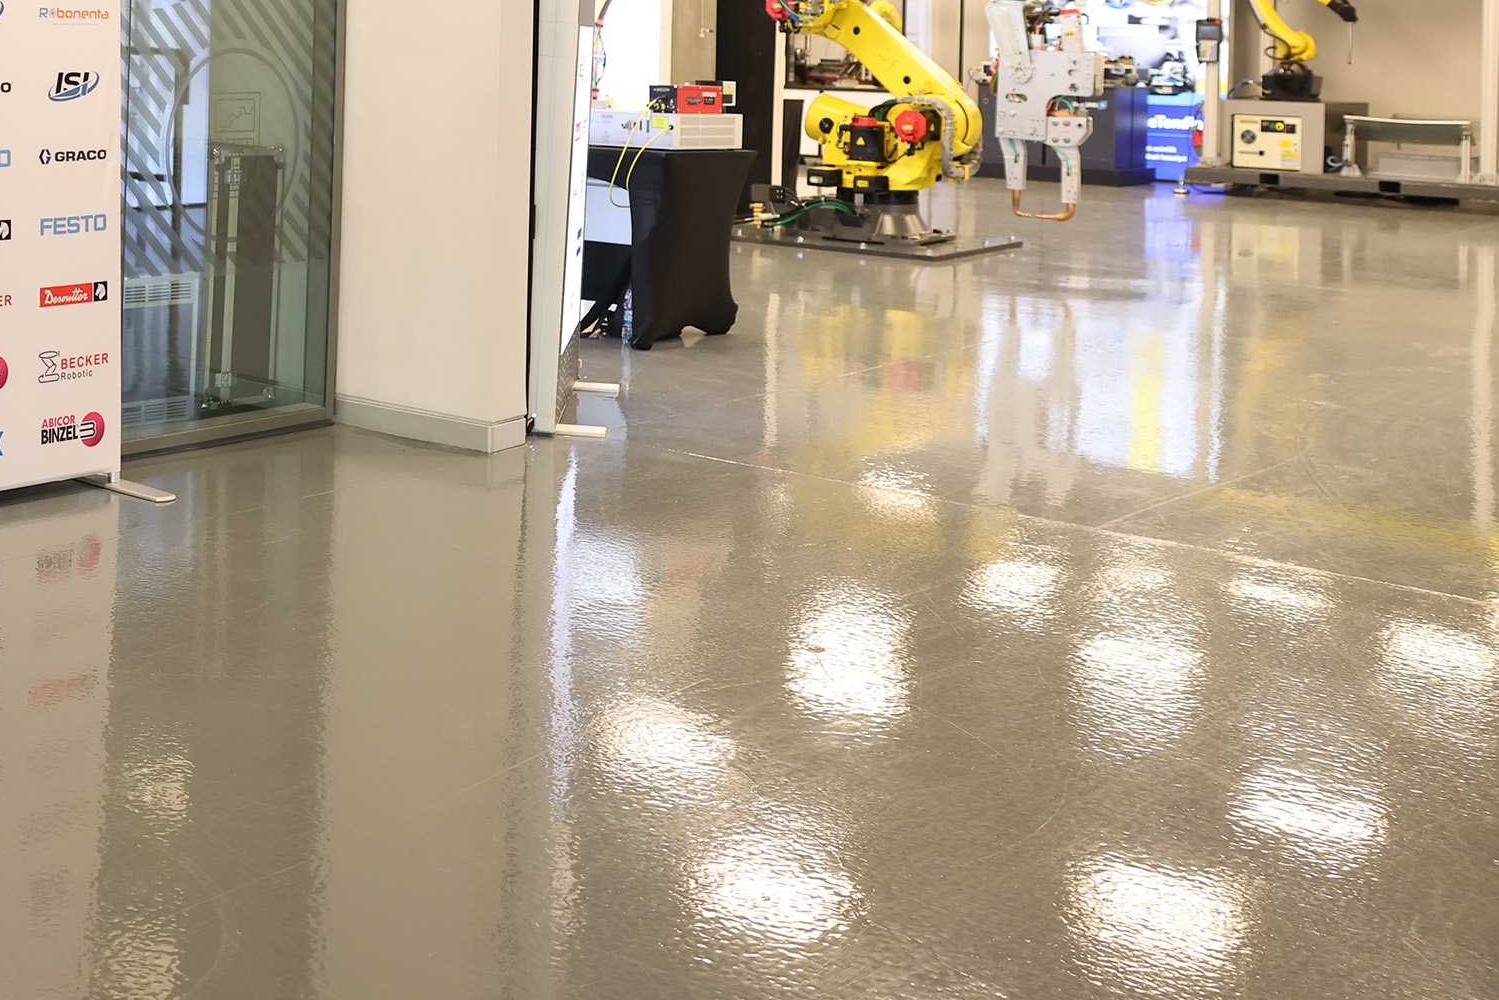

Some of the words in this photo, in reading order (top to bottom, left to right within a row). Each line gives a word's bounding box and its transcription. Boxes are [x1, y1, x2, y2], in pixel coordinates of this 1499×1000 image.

[55, 72, 89, 99] ISI
[55, 150, 106, 161] GRACO
[41, 214, 106, 236] FESTO
[45, 288, 88, 304] Desoutter
[62, 353, 108, 369] BECKER
[60, 368, 93, 380] Robotic
[42, 416, 75, 428] ABICOR
